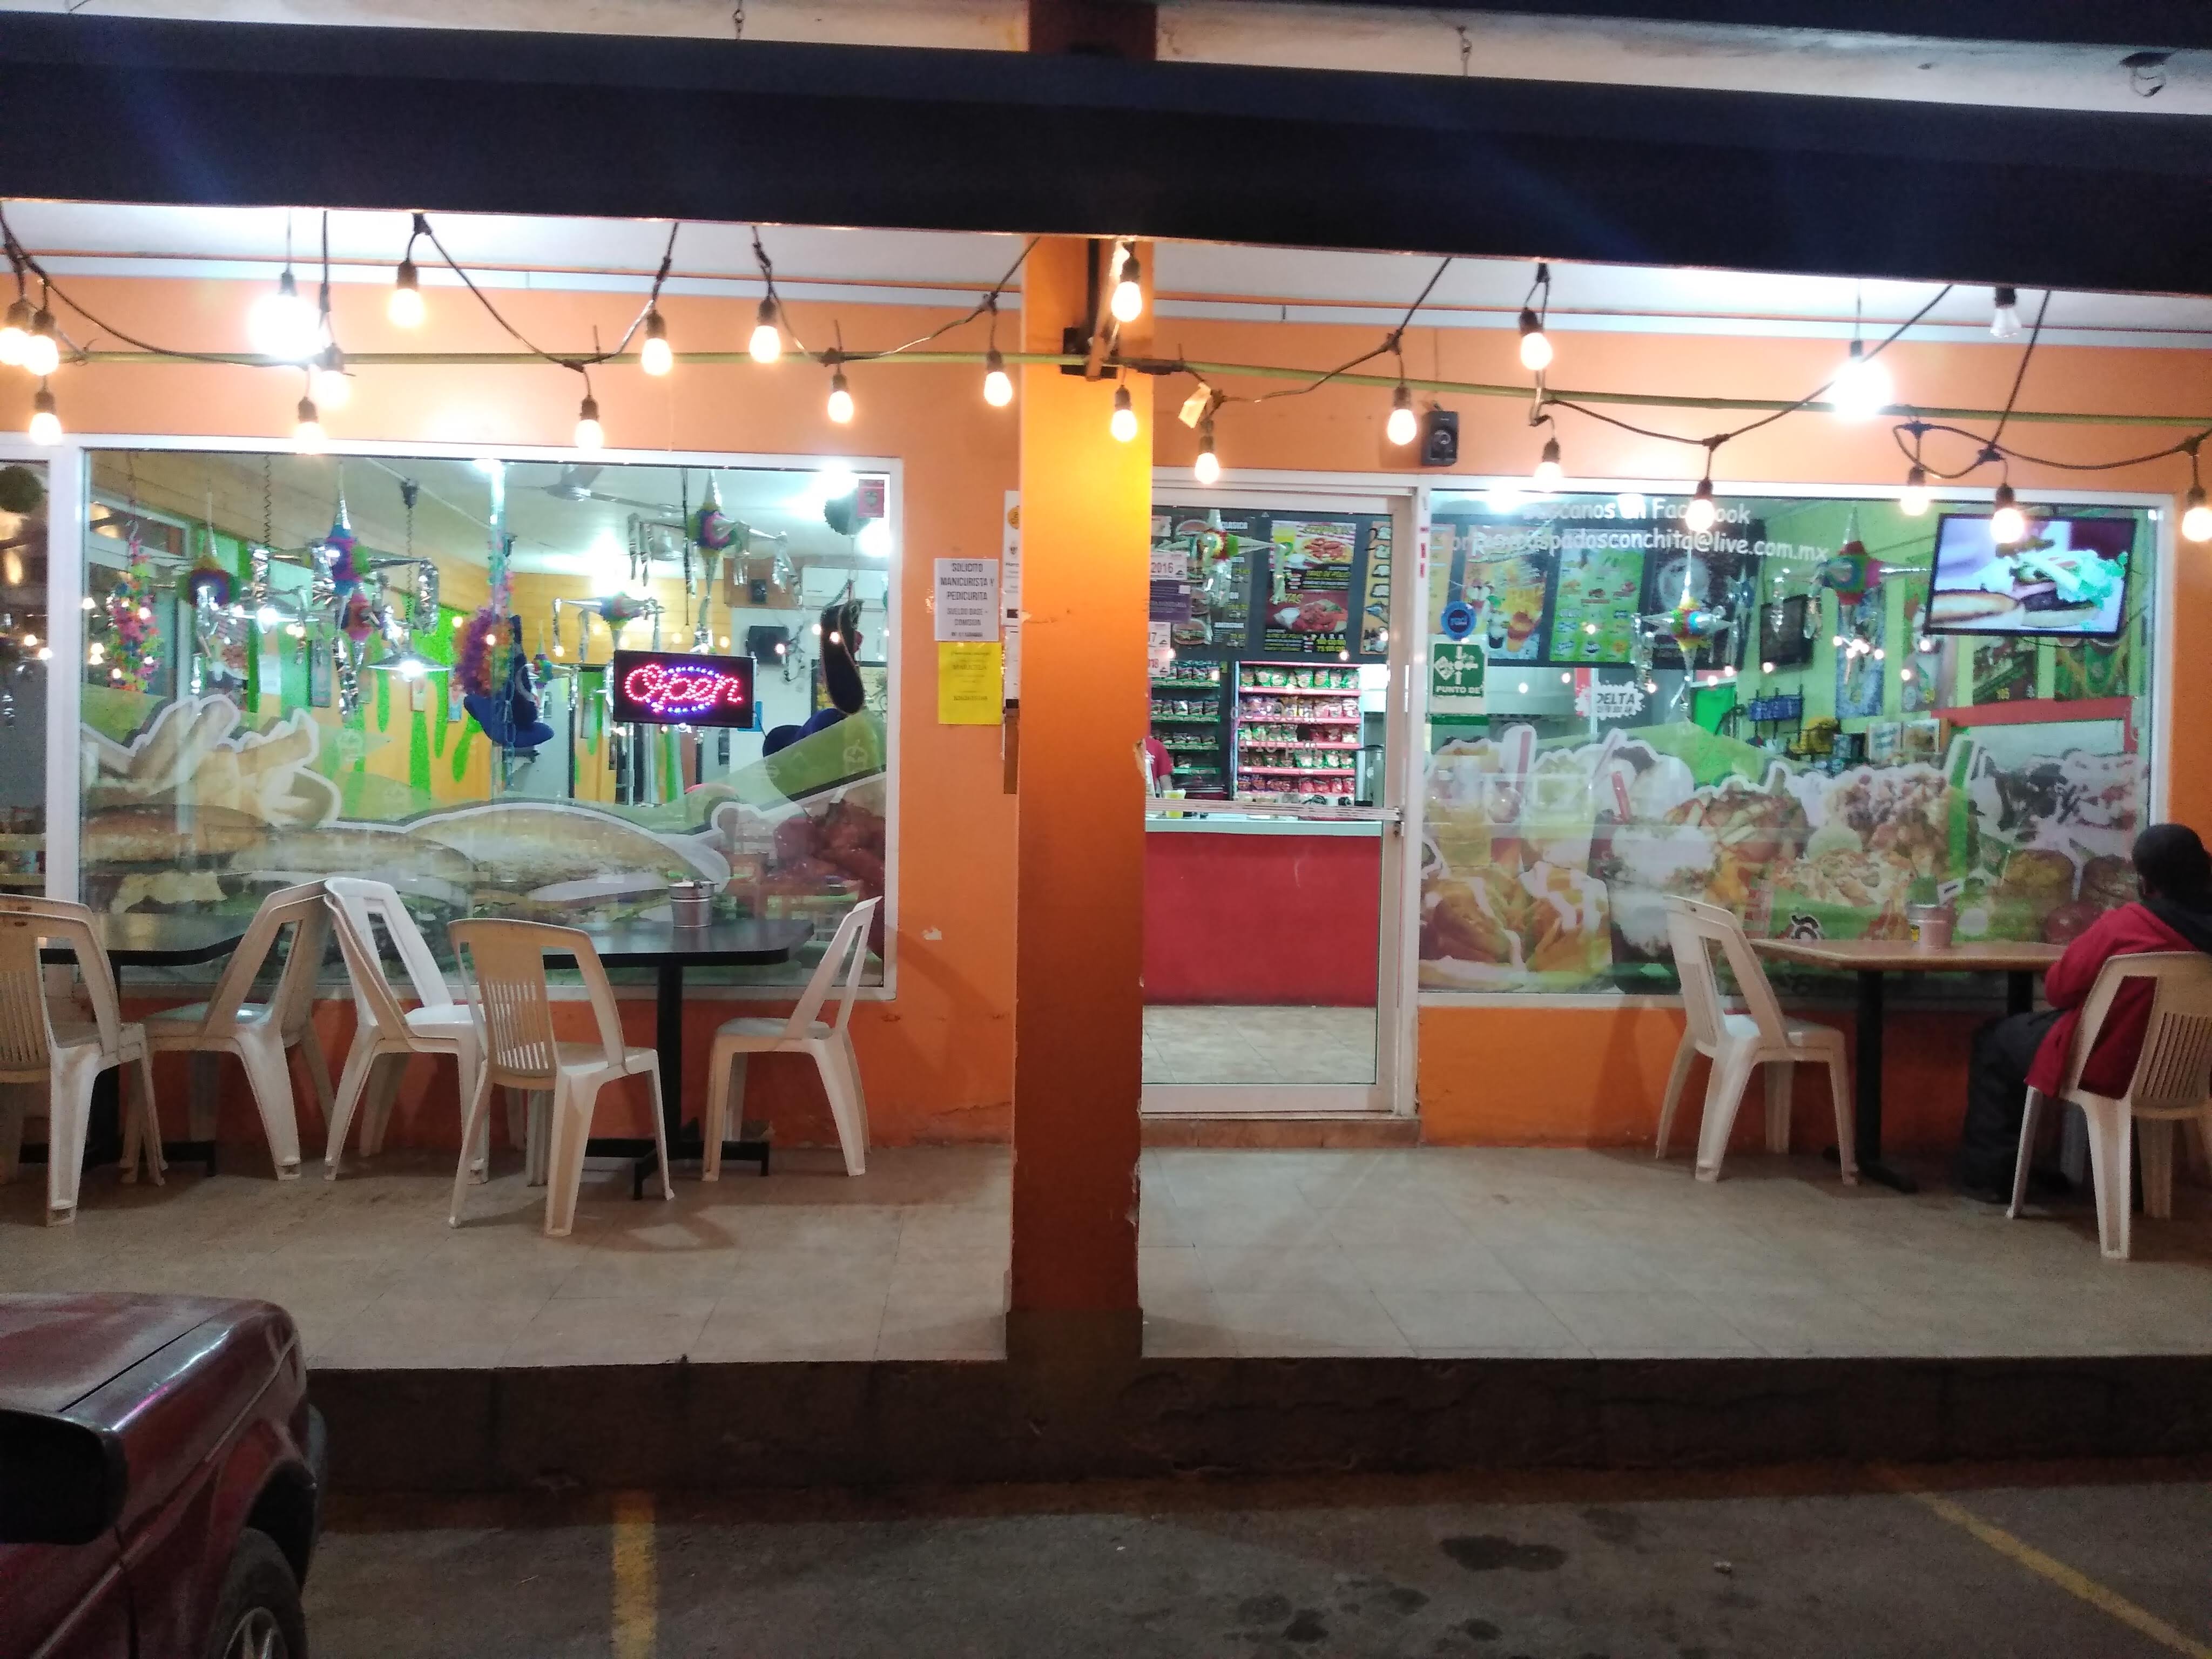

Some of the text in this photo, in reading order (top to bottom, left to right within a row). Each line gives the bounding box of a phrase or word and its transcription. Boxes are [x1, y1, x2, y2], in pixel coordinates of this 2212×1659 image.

[1651, 497, 1751, 524] Facook
[952, 563, 983, 572] SOLICITO
[1150, 562, 1174, 574] 2016
[940, 577, 988, 587] MANICURISTA
[990, 578, 995, 587] Y
[946, 591, 988, 601] PEDICURITA
[624, 663, 743, 713] Open
